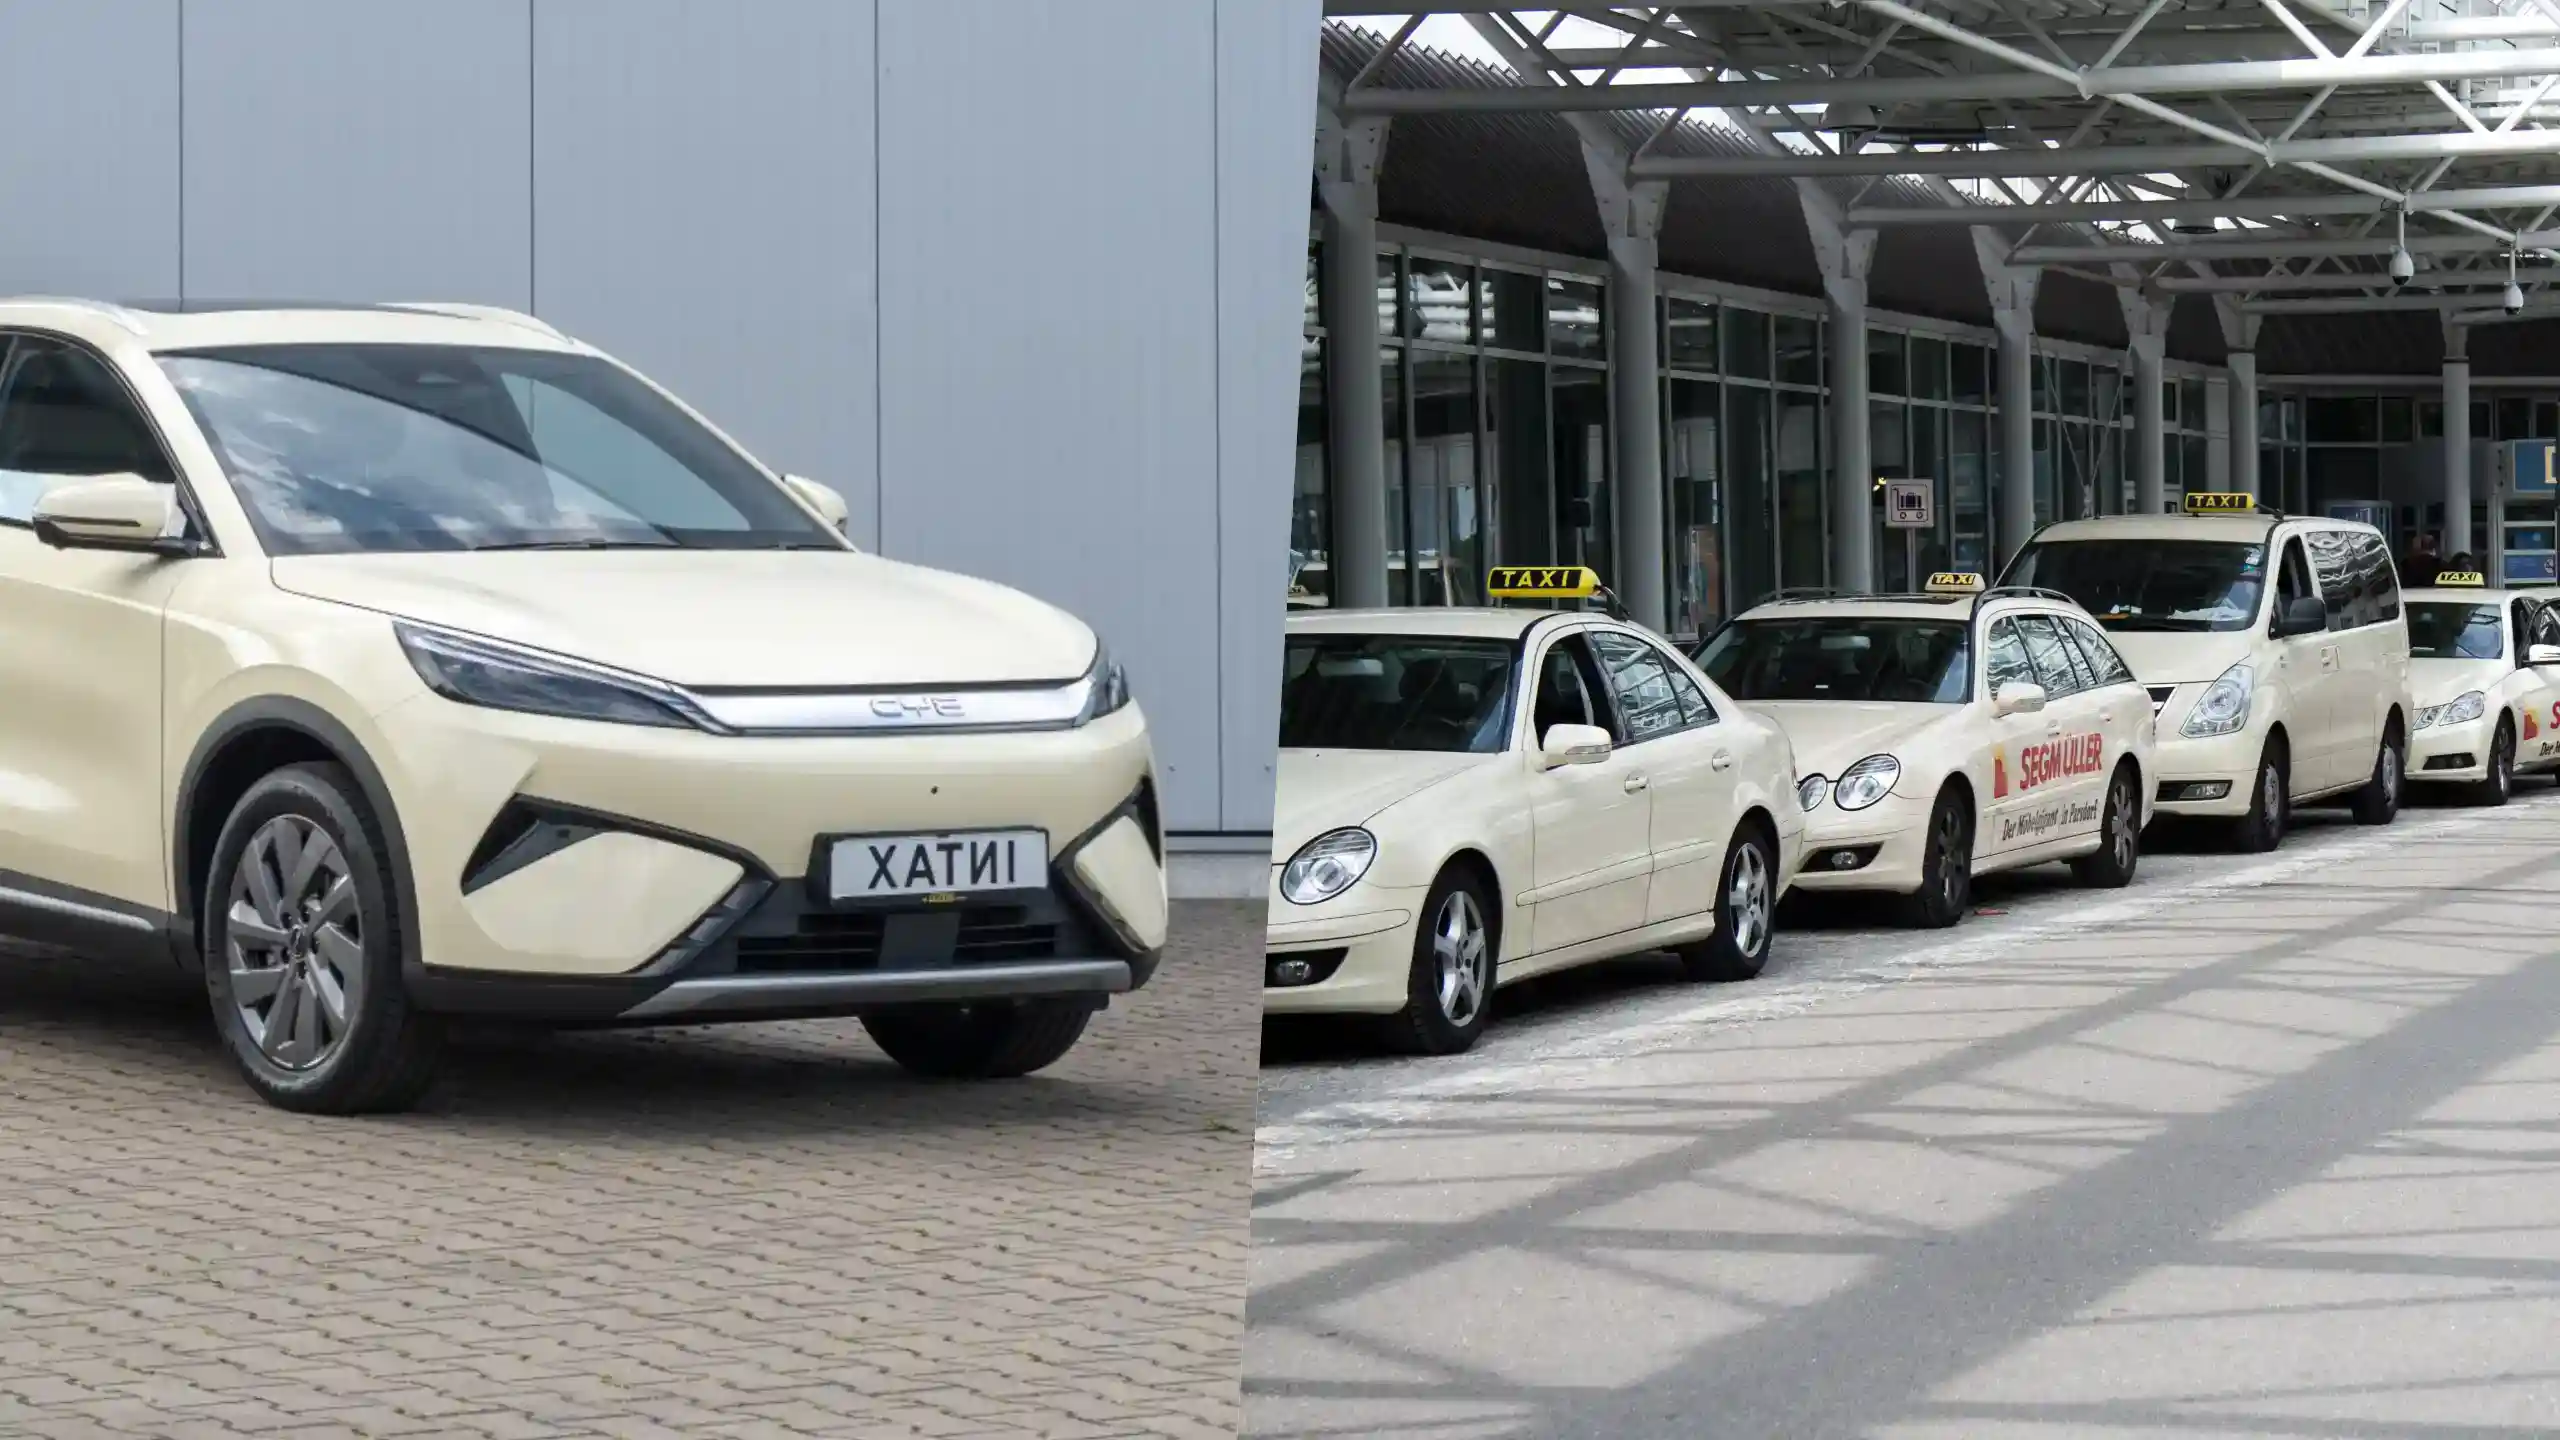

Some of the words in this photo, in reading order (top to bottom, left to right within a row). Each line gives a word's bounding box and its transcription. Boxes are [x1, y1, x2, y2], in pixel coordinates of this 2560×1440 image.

[2194, 495, 2239, 507] TAXI
[1502, 570, 1569, 587] TAXI
[1935, 574, 1975, 585] TAXI
[2441, 571, 2476, 581] TAXI
[2020, 732, 2102, 791] SEGMÜLLER
[2002, 818, 2017, 841] Der
